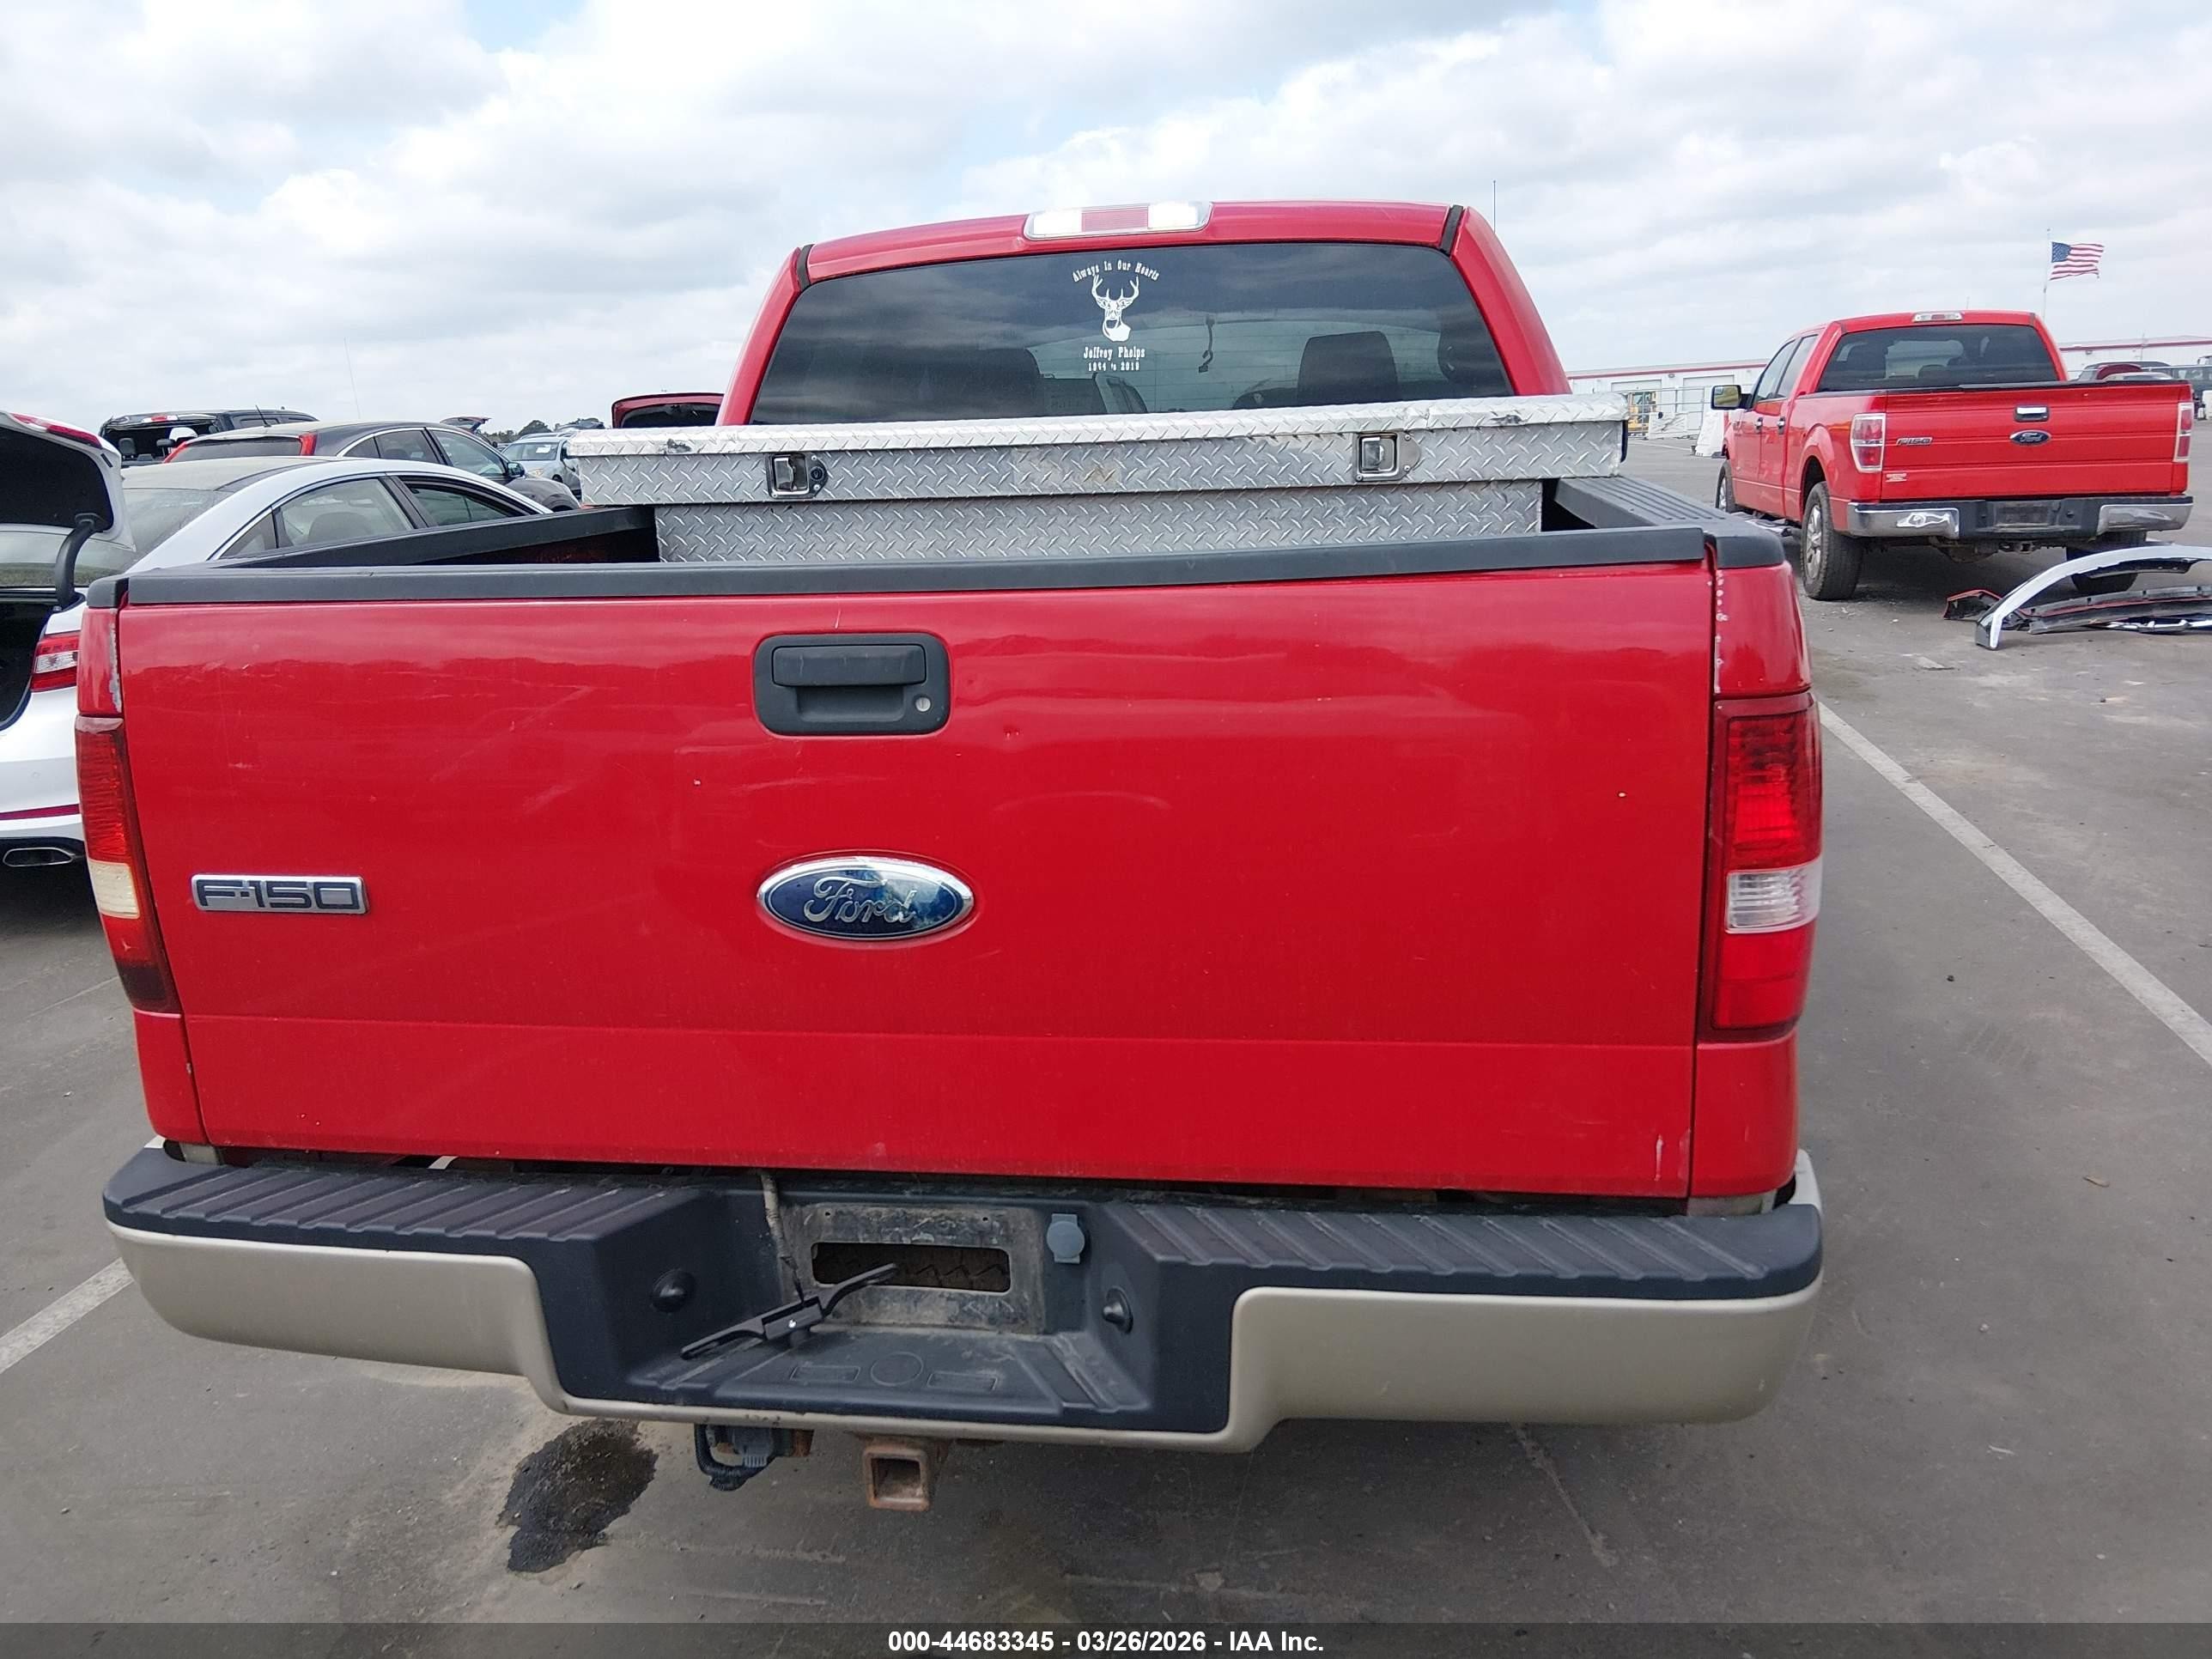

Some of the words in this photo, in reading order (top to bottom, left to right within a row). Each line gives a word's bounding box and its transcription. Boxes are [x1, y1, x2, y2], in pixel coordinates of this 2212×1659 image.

[1073, 264, 1100, 283] Always
[1103, 261, 1112, 271] In
[1117, 259, 1131, 271] Our
[1135, 262, 1159, 282] Hearts
[1083, 346, 1113, 361] Jeffrey
[1118, 345, 1146, 361] Phelps
[196, 878, 361, 910] F-150
[804, 876, 918, 923] Ford
